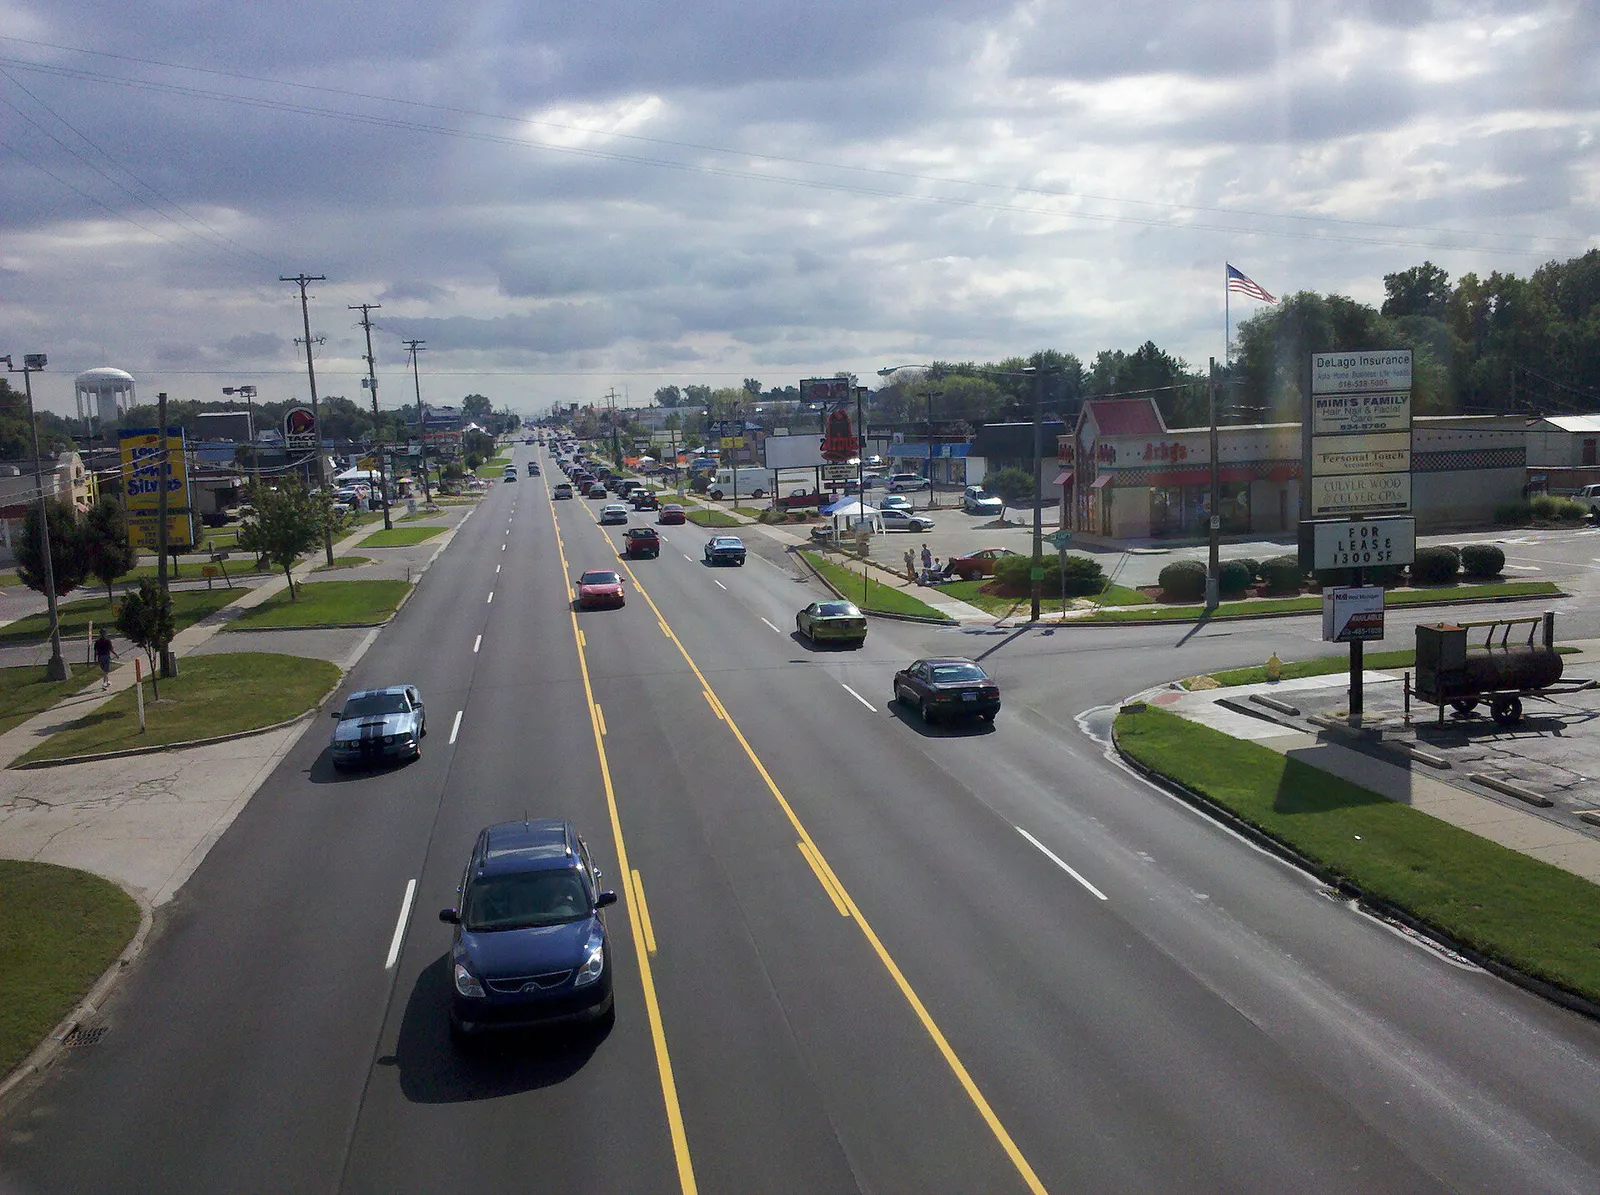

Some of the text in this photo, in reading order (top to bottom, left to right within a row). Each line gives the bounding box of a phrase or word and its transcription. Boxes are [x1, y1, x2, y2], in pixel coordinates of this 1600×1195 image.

[1317, 356, 1410, 369] DeLago Insurance
[1363, 396, 1408, 406] FAMILY
[1345, 407, 1362, 415] Nail
[1364, 406, 1372, 414] &
[1374, 405, 1401, 413] Facial
[1350, 414, 1373, 422] Care
[1143, 441, 1187, 463] Arby's
[1322, 452, 1404, 463] Personal Touch
[1324, 478, 1402, 492] CULVER WOOD
[1349, 526, 1379, 538] FOR
[1338, 538, 1391, 552] LEASE
[1333, 551, 1392, 564] 1300 SF
